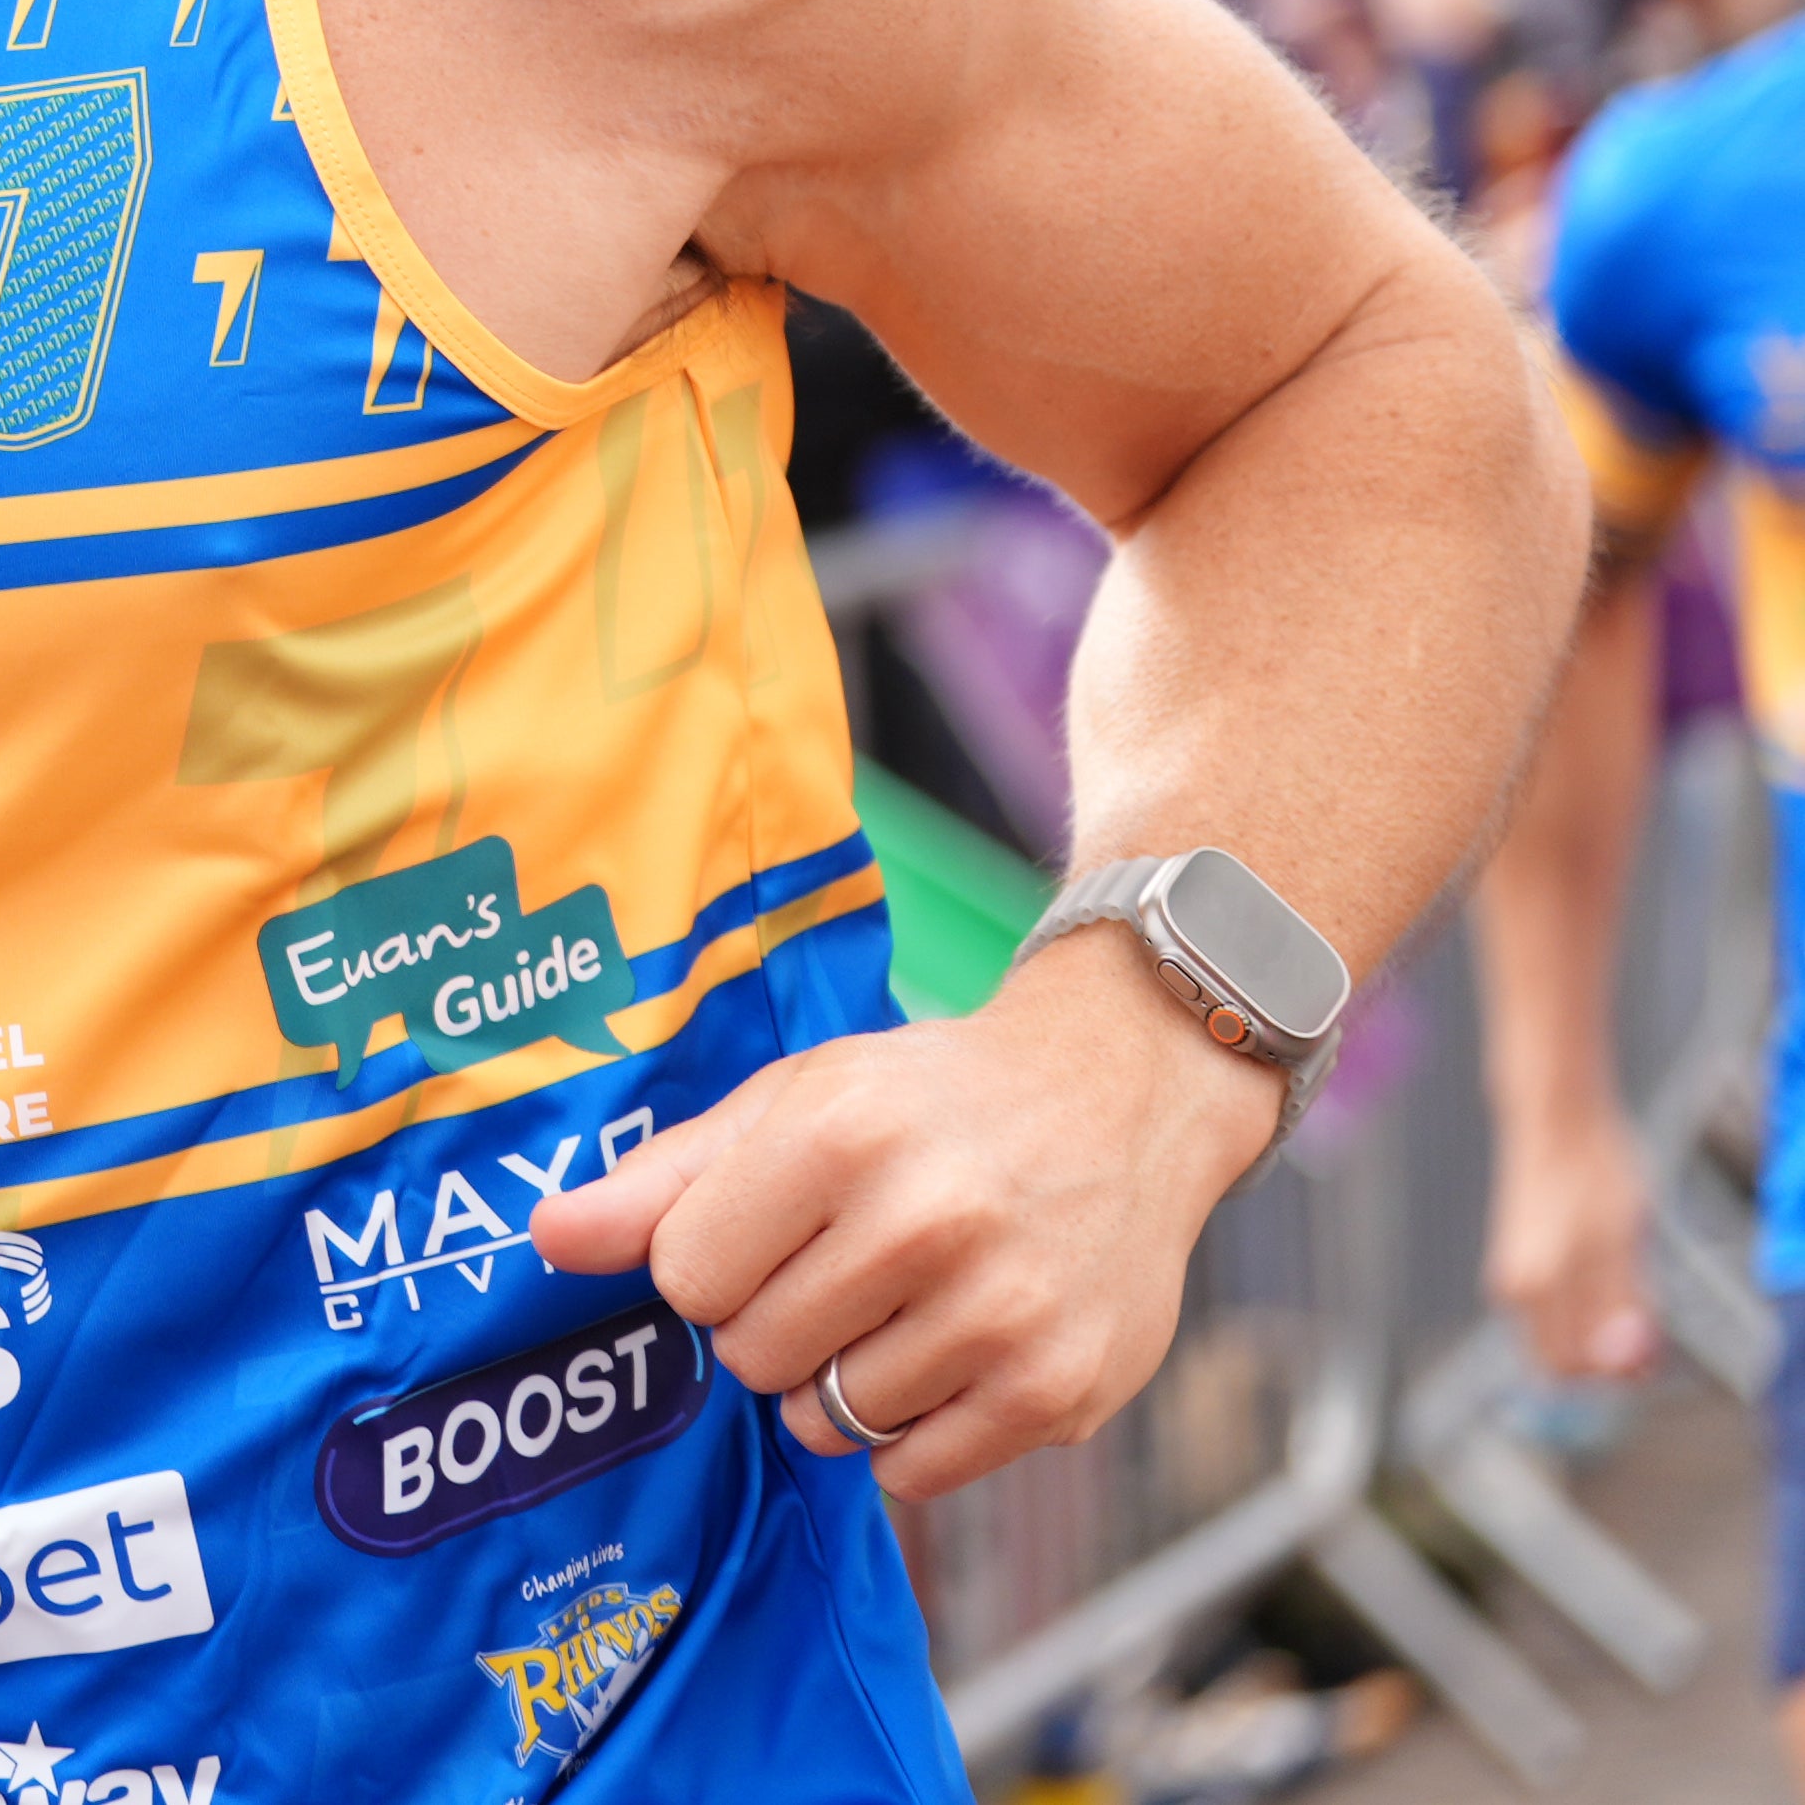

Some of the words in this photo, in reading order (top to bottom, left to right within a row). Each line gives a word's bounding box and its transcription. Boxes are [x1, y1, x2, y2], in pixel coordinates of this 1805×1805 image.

[192, 249, 264, 368] 7
[285, 891, 503, 1007] Euan's
[433, 935, 603, 1038] Guide
[323, 1254, 555, 1331] CIV
[382, 1323, 658, 1515] BOOST
[521, 1554, 591, 1602] Changing
